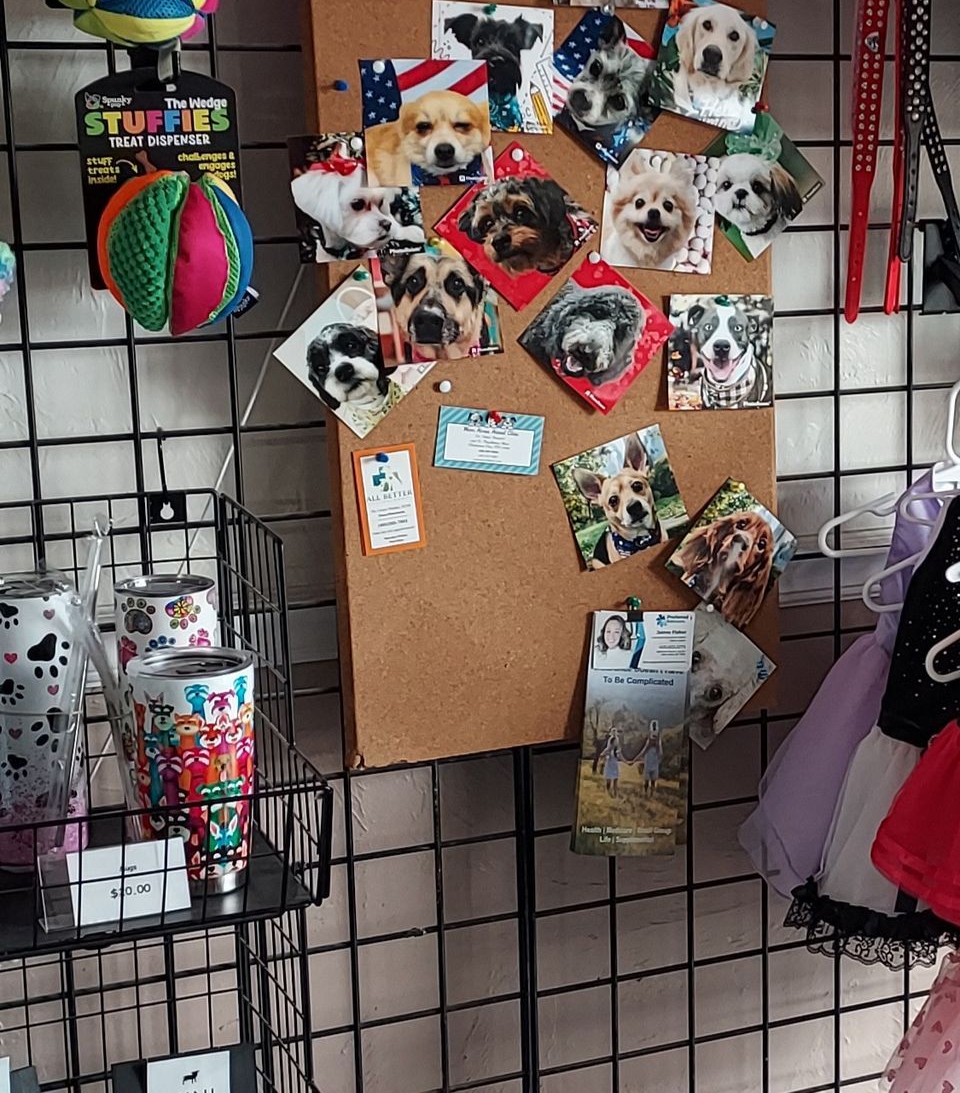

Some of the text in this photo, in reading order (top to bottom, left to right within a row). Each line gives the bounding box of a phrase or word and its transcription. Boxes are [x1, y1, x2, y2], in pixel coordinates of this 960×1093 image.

[102, 95, 132, 106] Spunky
[164, 96, 228, 111] The Wedge
[84, 108, 231, 136] STUFFIES
[109, 134, 211, 148] TREAT DISPENSER
[86, 157, 113, 166] stuff
[178, 152, 226, 162] challenges
[87, 166, 120, 174] treats
[198, 162, 236, 171] engages
[88, 175, 117, 184] inside!
[614, 676, 625, 684] Be
[627, 677, 674, 686] Complicated
[110, 883, 151, 899] $0.00
